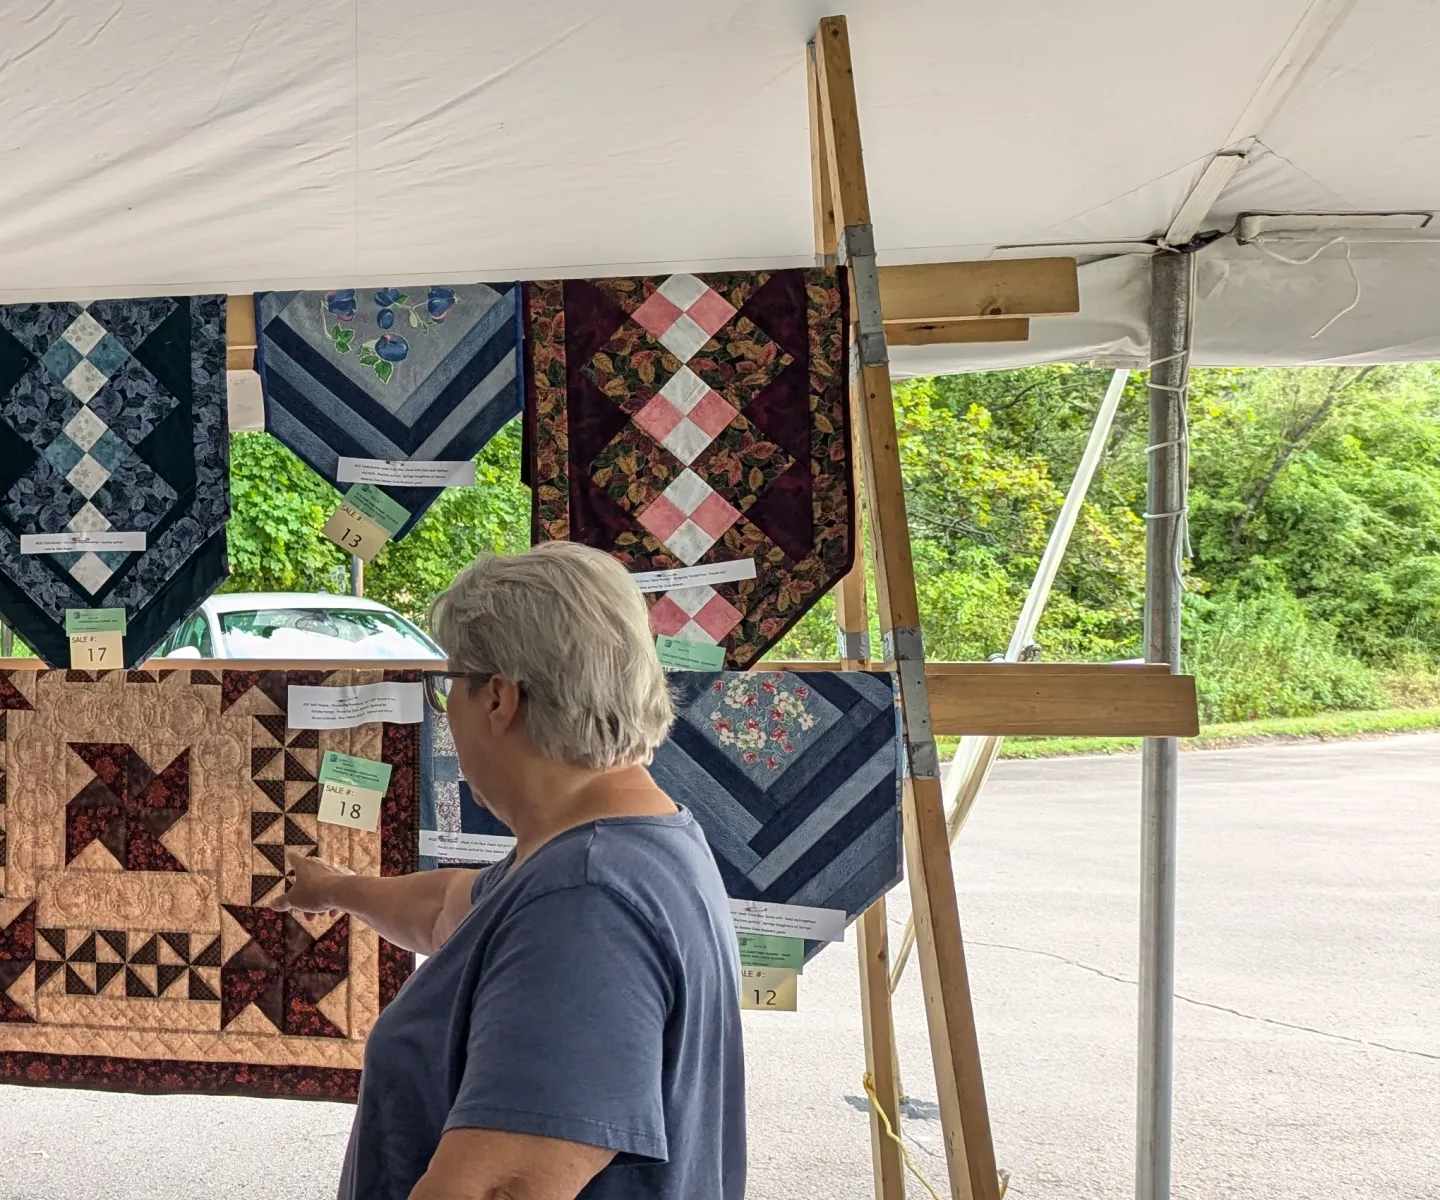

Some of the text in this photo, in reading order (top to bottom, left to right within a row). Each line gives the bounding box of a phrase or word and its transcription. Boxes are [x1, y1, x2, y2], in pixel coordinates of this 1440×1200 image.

[340, 504, 357, 519] SALE
[341, 527, 363, 548] 13
[71, 635, 87, 643] SALE
[87, 647, 107, 662] 17
[326, 784, 345, 795] SALE
[340, 801, 362, 819] 18
[753, 989, 777, 1006] 12
